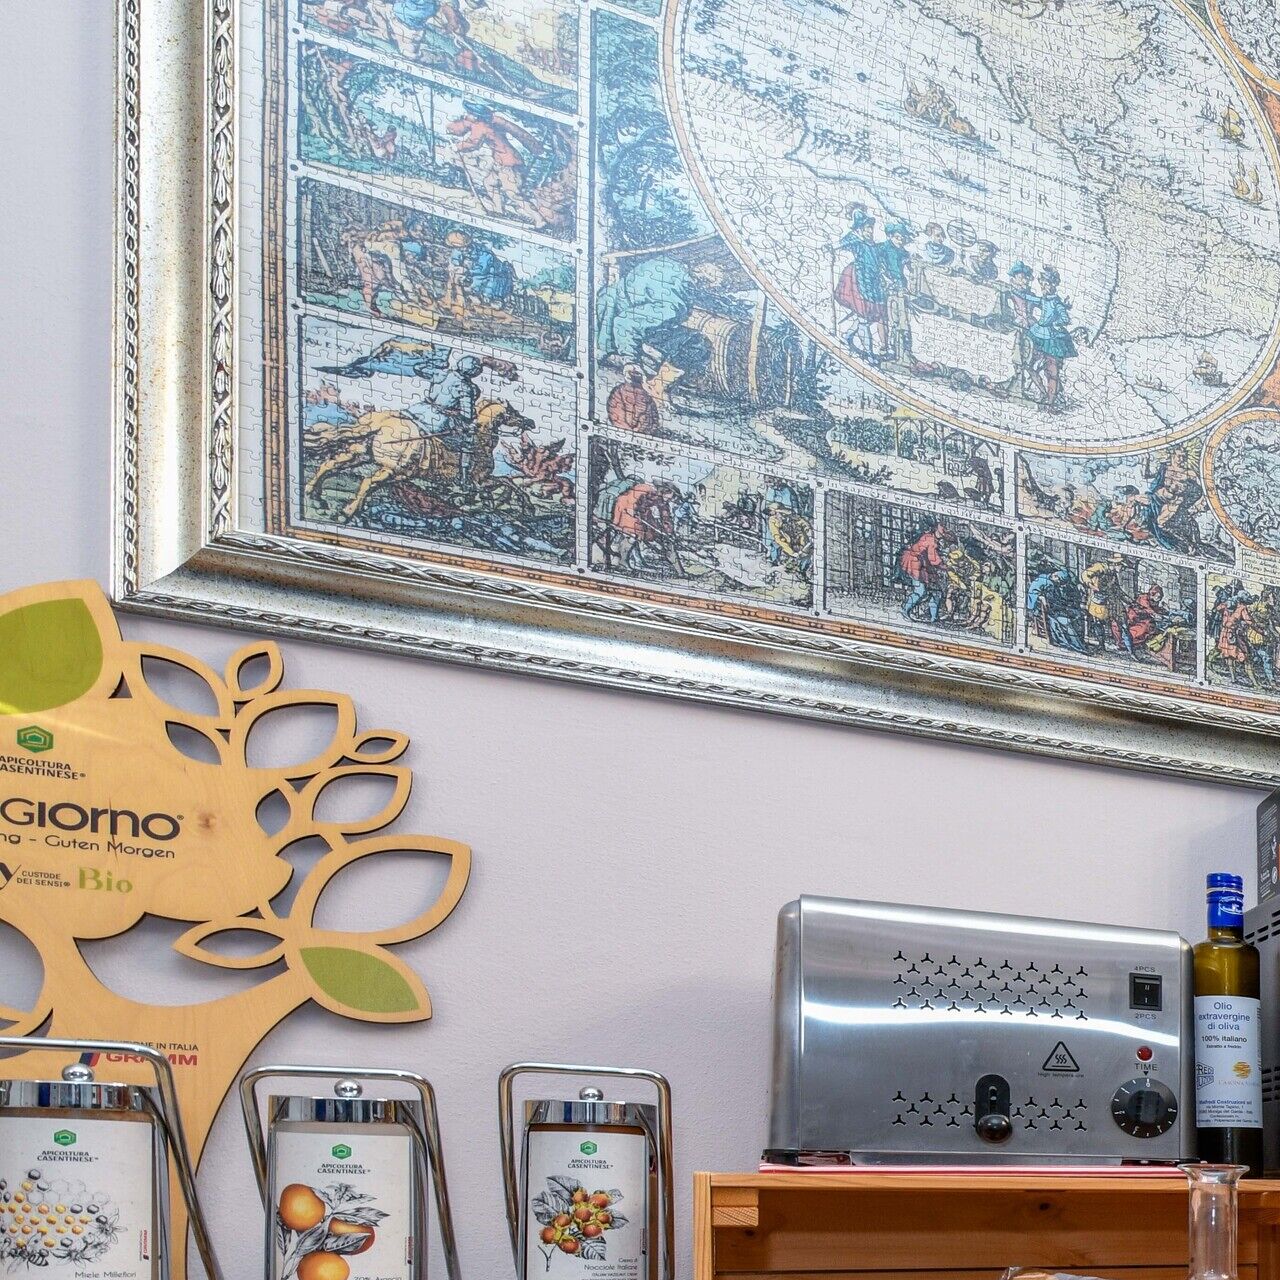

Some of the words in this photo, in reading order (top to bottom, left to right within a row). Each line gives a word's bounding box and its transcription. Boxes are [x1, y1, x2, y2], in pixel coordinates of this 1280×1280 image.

[0, 797, 185, 841] GIOrno®
[45, 834, 101, 852] Guten
[107, 841, 176, 860] Morgen
[21, 870, 62, 881] CUSTODE
[16, 878, 34, 887] DEI
[79, 866, 134, 895] Bio
[1213, 1001, 1233, 1010] Olio
[1134, 1012, 1157, 1020] 2PCS
[1198, 1011, 1251, 1022] extravergine
[1207, 1022, 1216, 1031] di
[1218, 1022, 1241, 1031] oliva
[1201, 1034, 1220, 1043] 100%
[1221, 1034, 1248, 1043] italiano
[156, 1041, 167, 1050] IN
[169, 1043, 199, 1052] ITALIA
[1134, 1062, 1159, 1071] TIME
[41, 1150, 91, 1158] APICOLTURA
